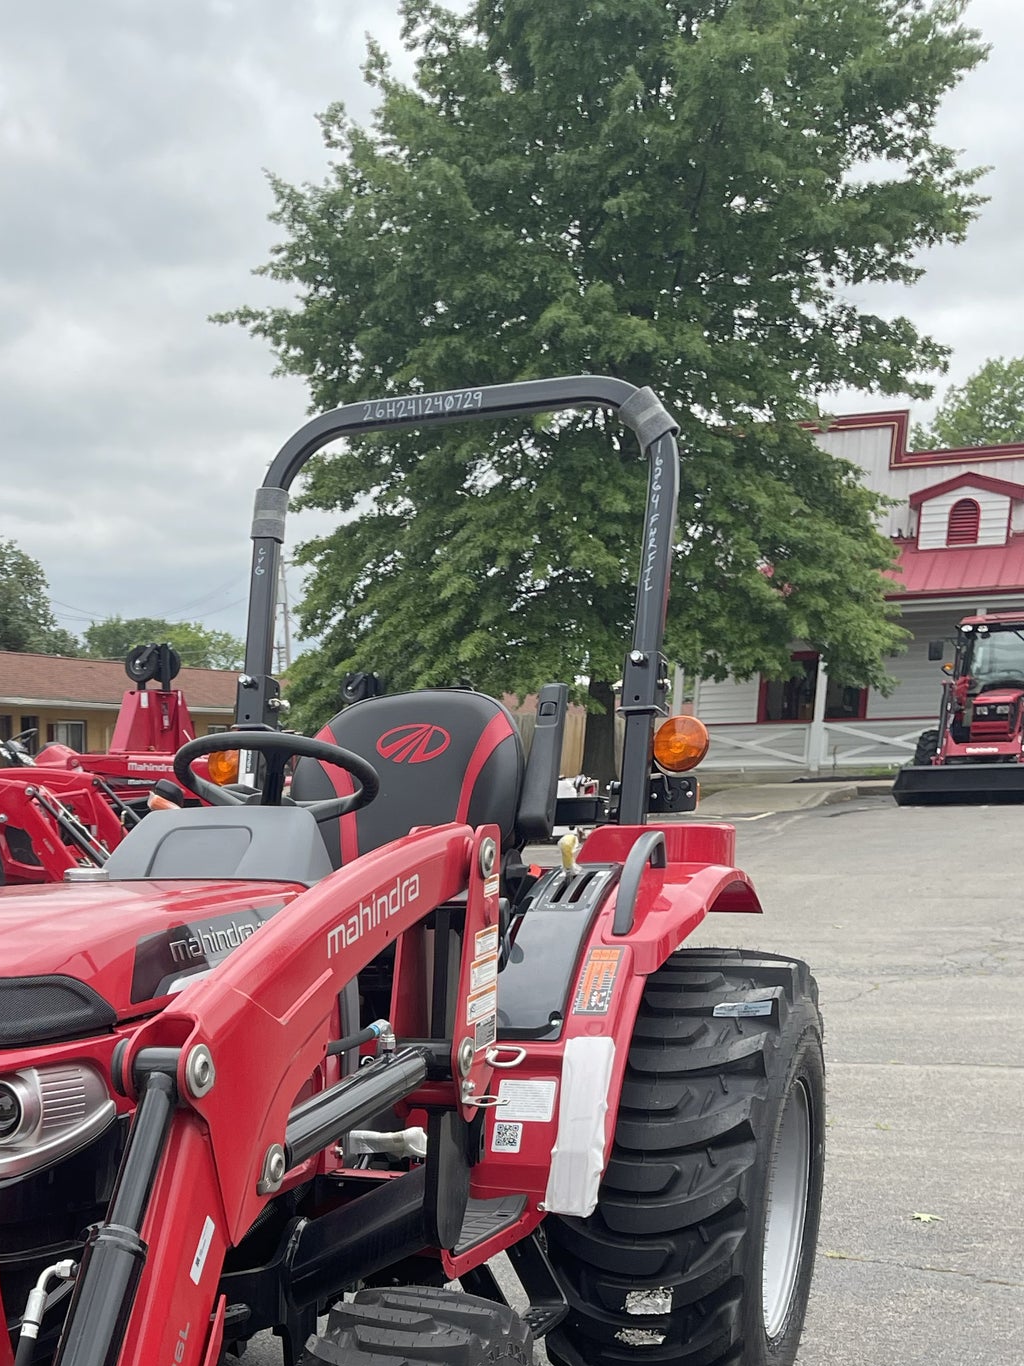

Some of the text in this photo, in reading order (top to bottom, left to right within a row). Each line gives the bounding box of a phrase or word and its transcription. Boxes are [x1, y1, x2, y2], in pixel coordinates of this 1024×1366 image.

[363, 391, 483, 420] 26H241240729
[327, 873, 419, 959] mahindra
[169, 921, 254, 962] mahindra
